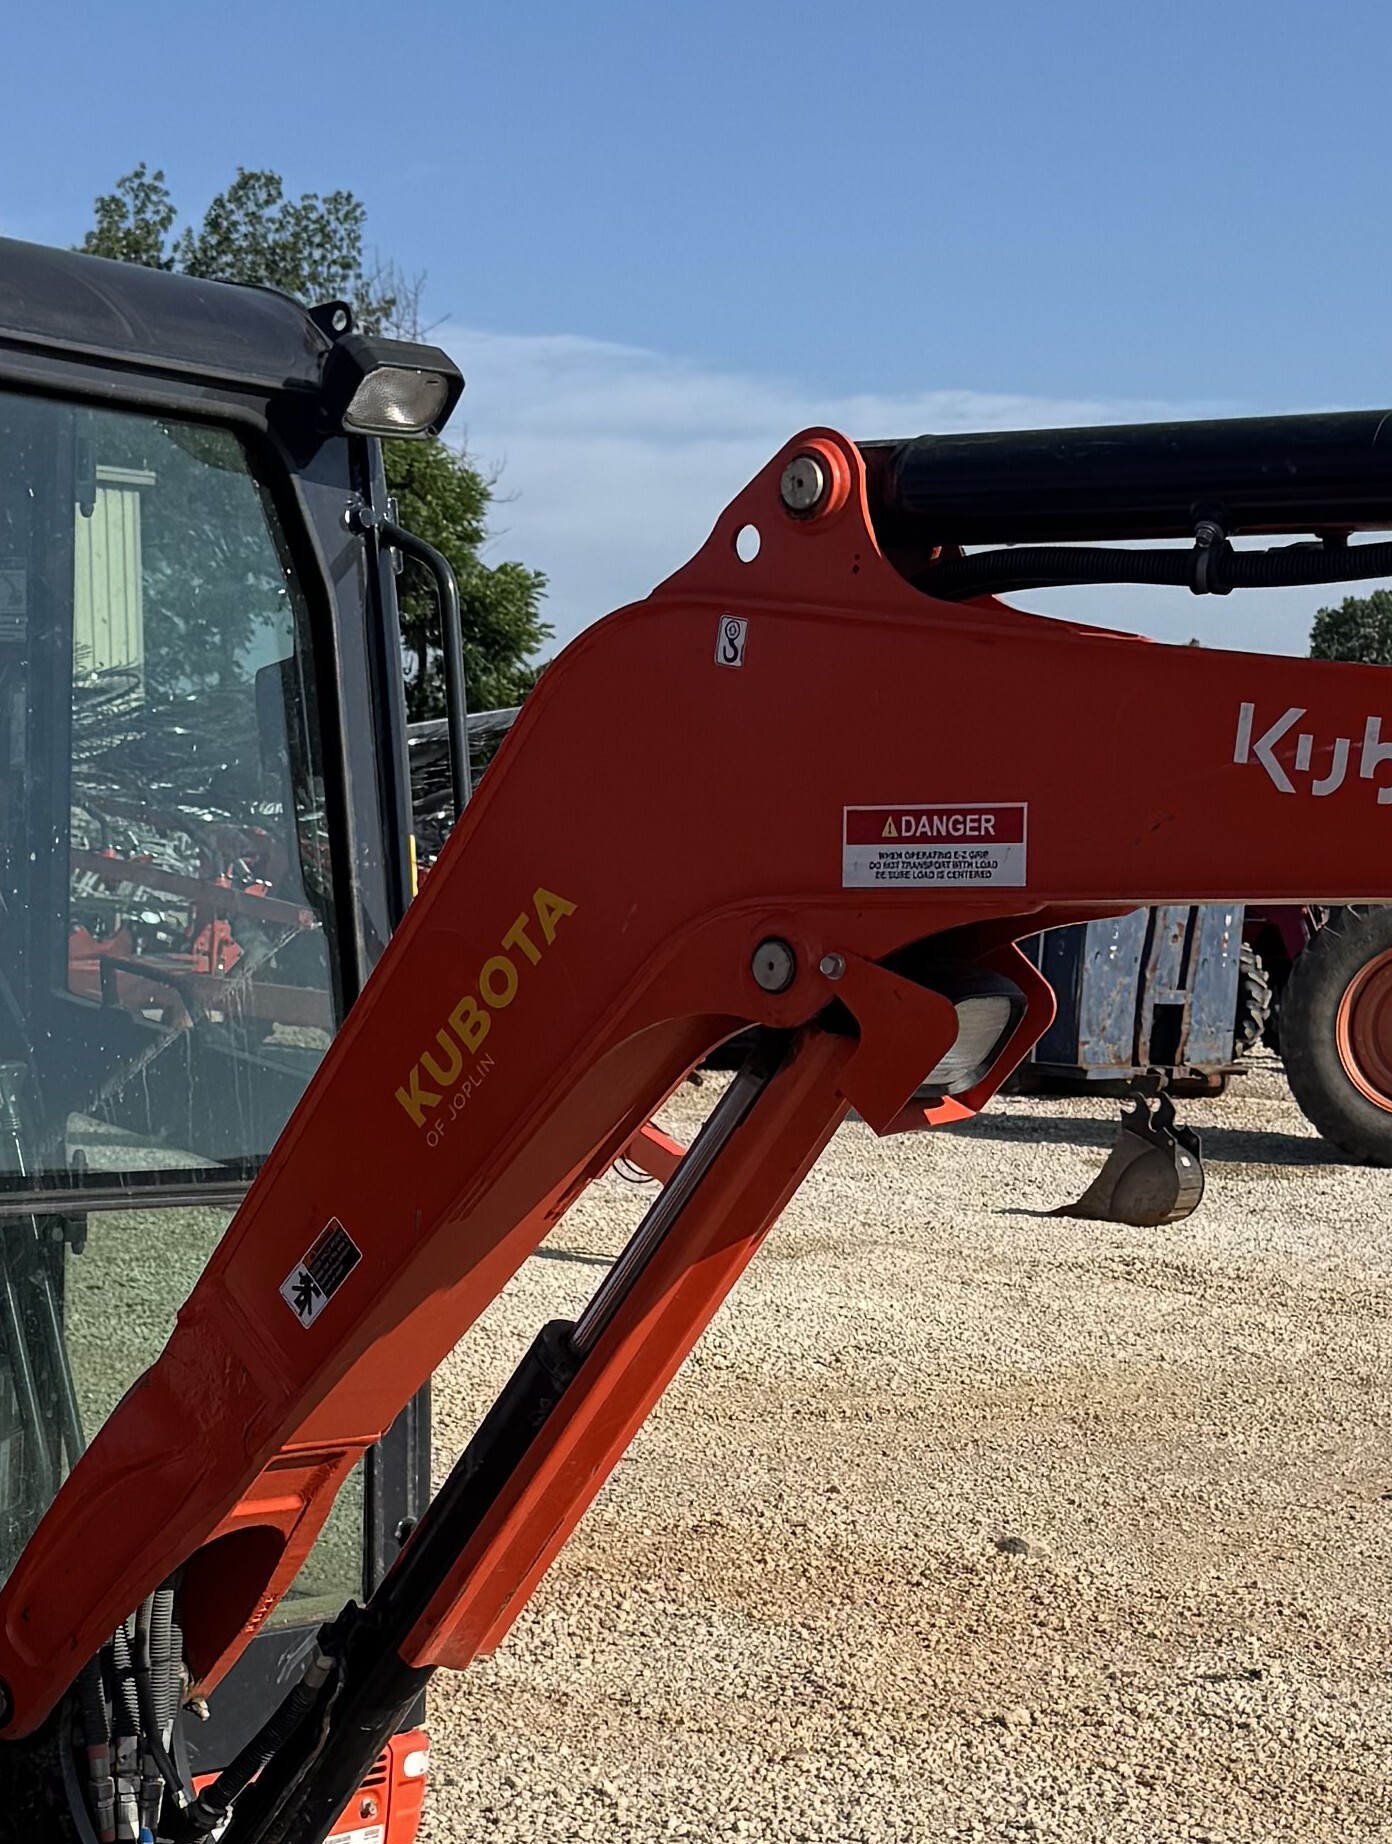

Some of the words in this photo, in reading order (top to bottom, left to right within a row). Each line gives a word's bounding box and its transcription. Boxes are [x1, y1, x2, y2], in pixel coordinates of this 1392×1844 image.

[901, 815, 996, 837] DANGER
[975, 860, 999, 869] LOAD
[394, 887, 578, 1128] KUBOTA
[426, 1118, 445, 1147] OF
[450, 1052, 496, 1121] JOPLIN
